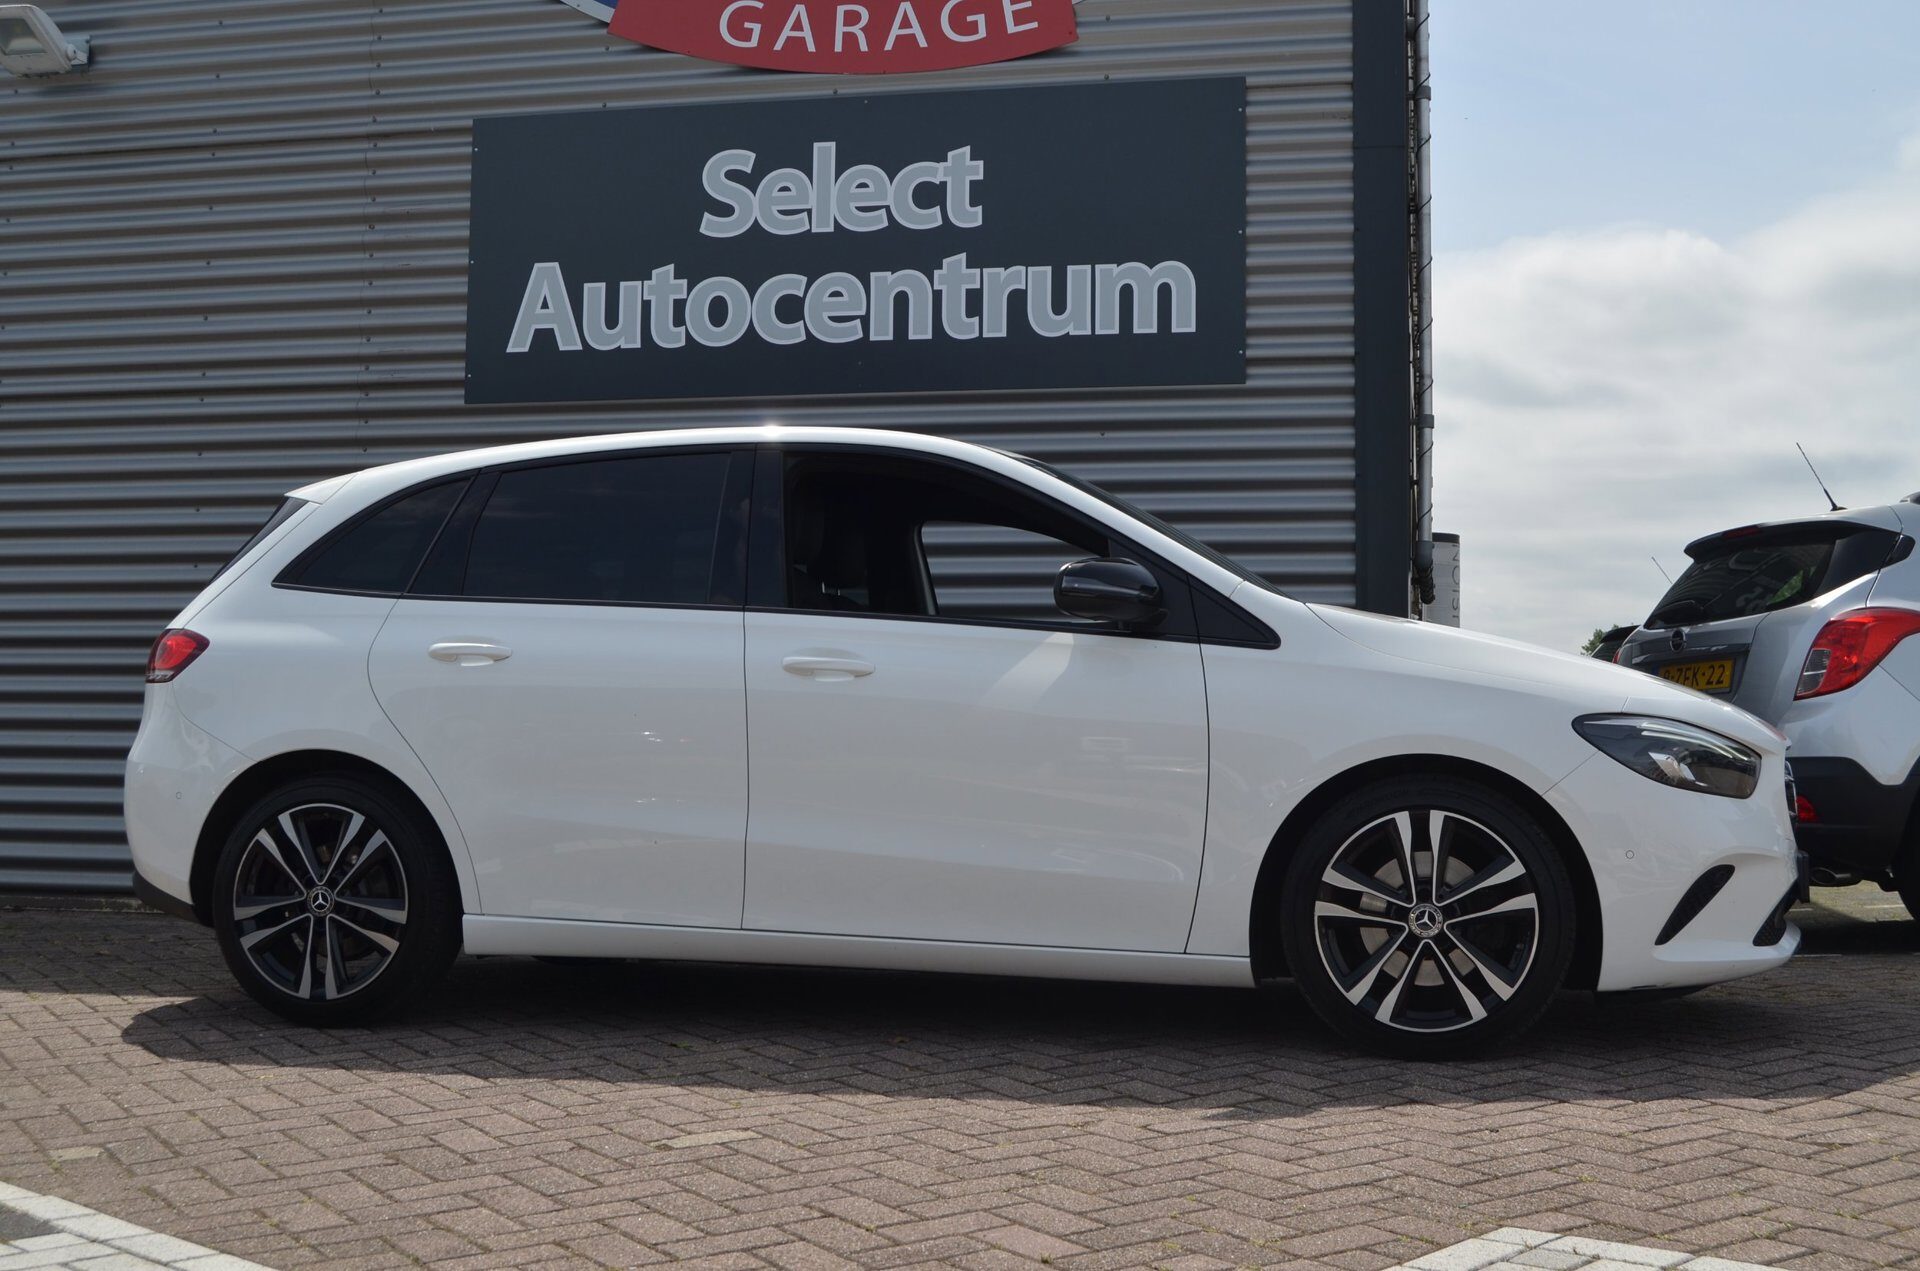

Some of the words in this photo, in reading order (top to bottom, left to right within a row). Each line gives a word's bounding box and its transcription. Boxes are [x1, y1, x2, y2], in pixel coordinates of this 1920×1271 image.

[718, 0, 1039, 53] GARAGE
[699, 141, 984, 238] Select
[506, 252, 1197, 354] Autocentrum
